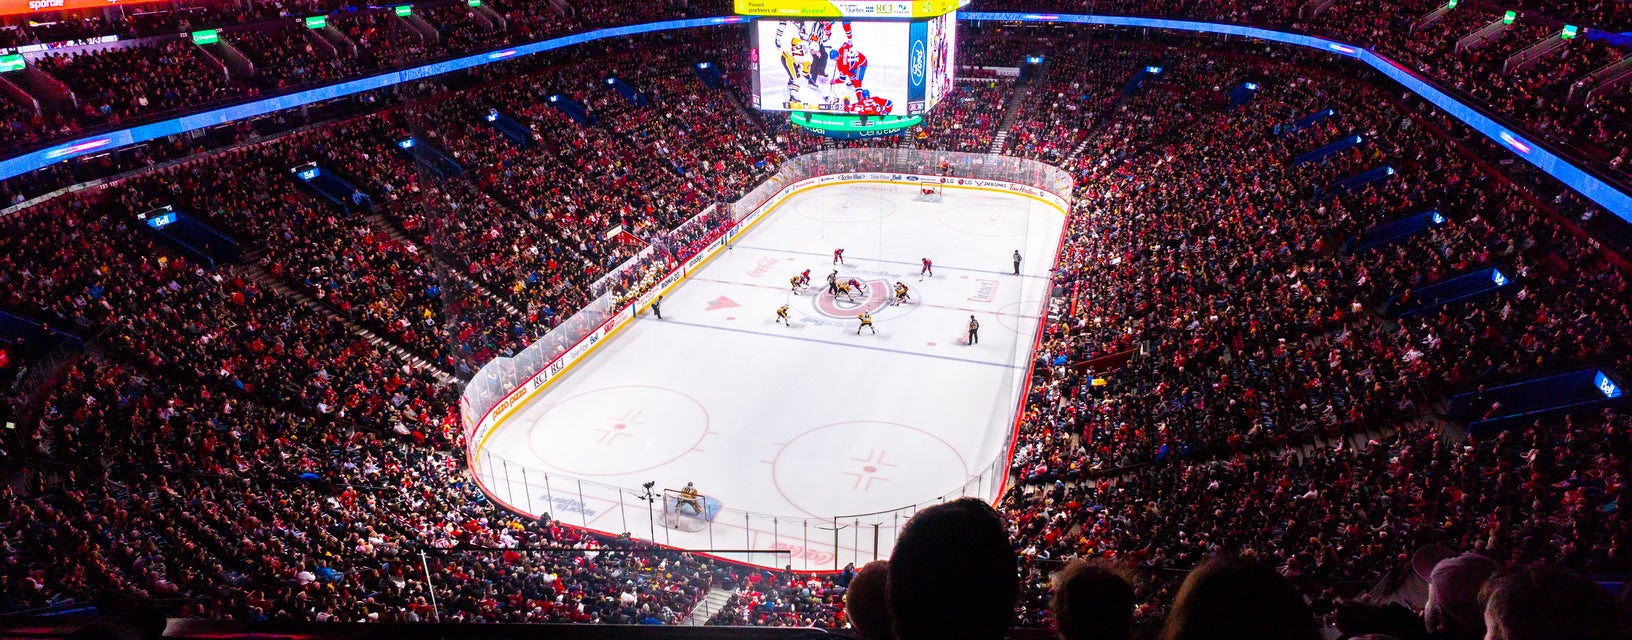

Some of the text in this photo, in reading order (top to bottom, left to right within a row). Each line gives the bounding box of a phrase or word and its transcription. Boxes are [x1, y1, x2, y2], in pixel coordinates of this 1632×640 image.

[1019, 186, 1038, 196] Hortons
[155, 215, 169, 227] Bell
[589, 331, 600, 345] Bell
[533, 357, 565, 388] RCI RCI
[1600, 377, 1615, 394] Bell
[492, 387, 528, 422] pizza pizza
